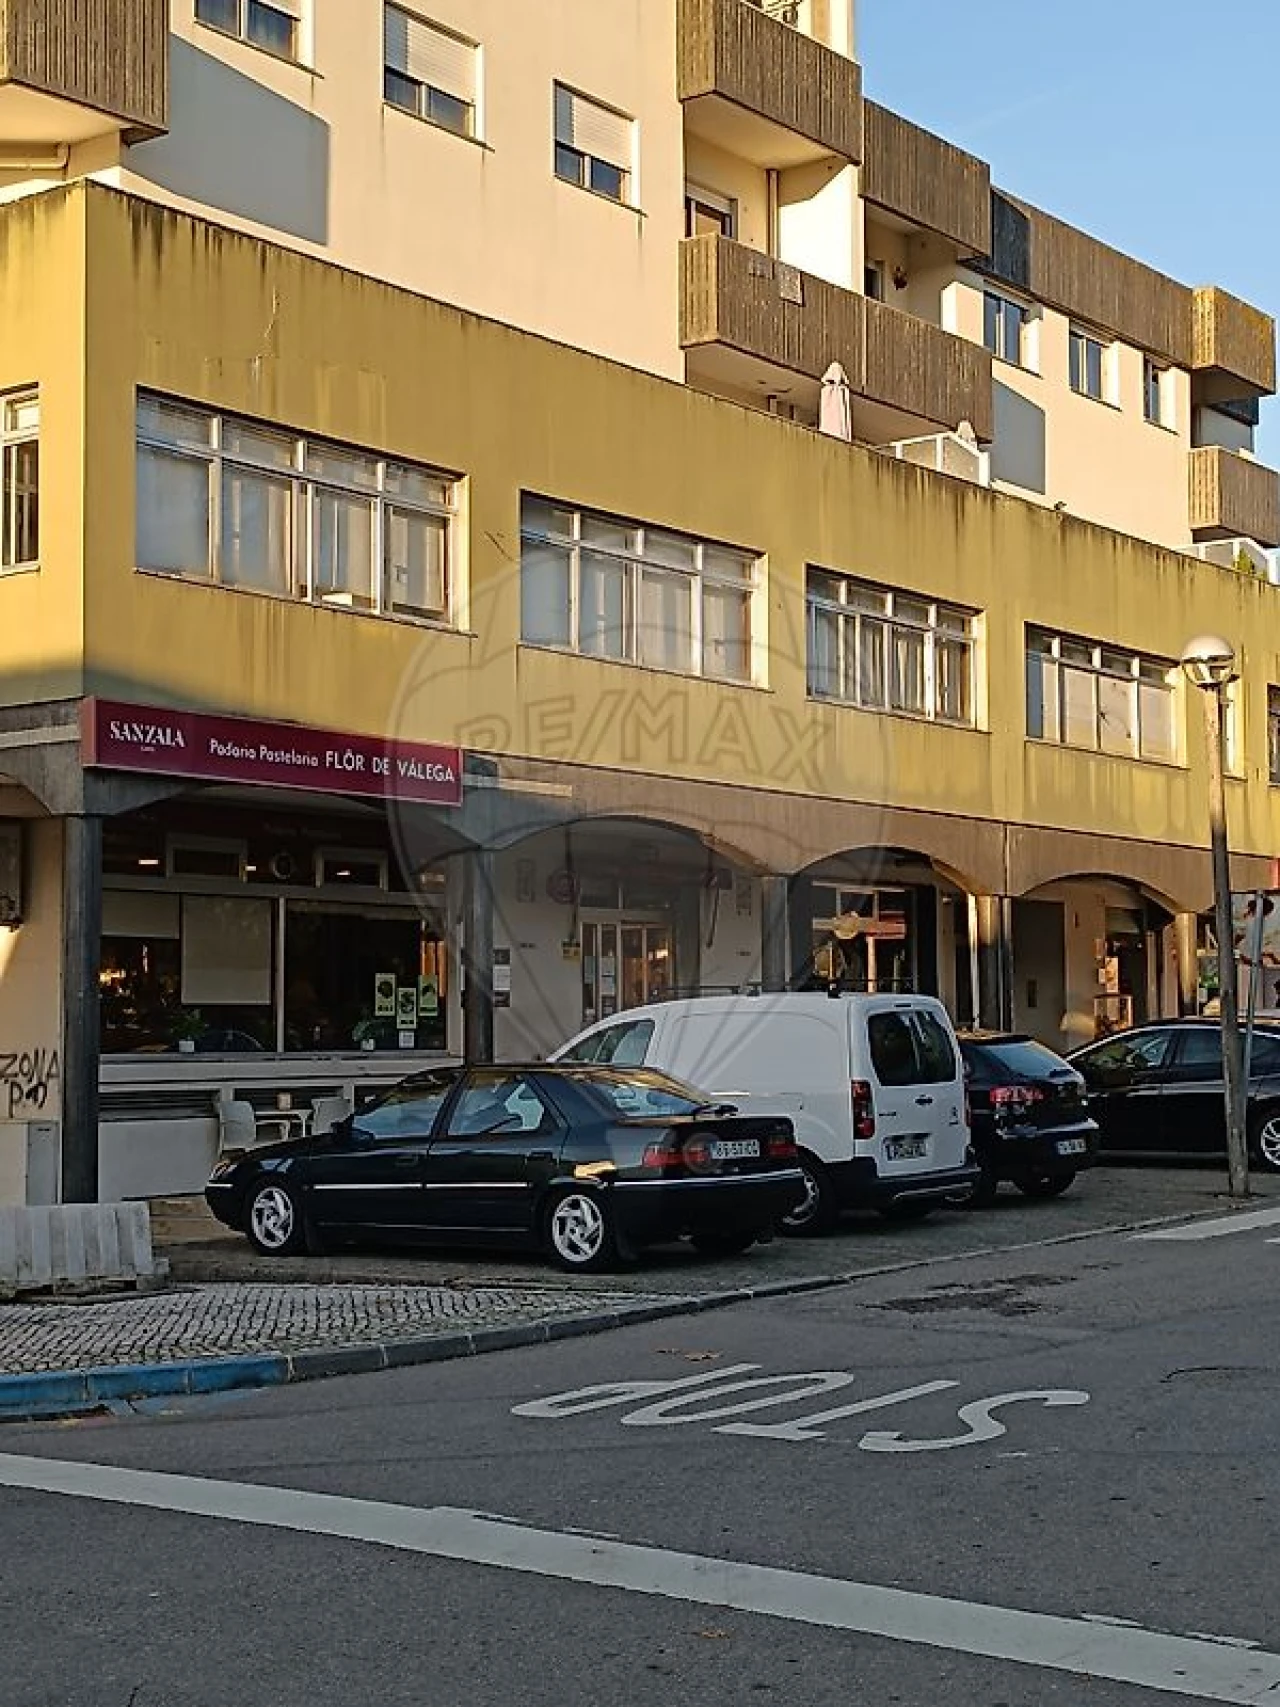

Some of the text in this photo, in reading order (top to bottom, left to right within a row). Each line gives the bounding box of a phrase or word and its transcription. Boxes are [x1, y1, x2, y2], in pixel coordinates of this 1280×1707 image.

[259, 745, 318, 767] Pastelaria
[372, 757, 390, 776] DE
[397, 758, 455, 782] VÁLEGA
[511, 1363, 1090, 1452] STOP
